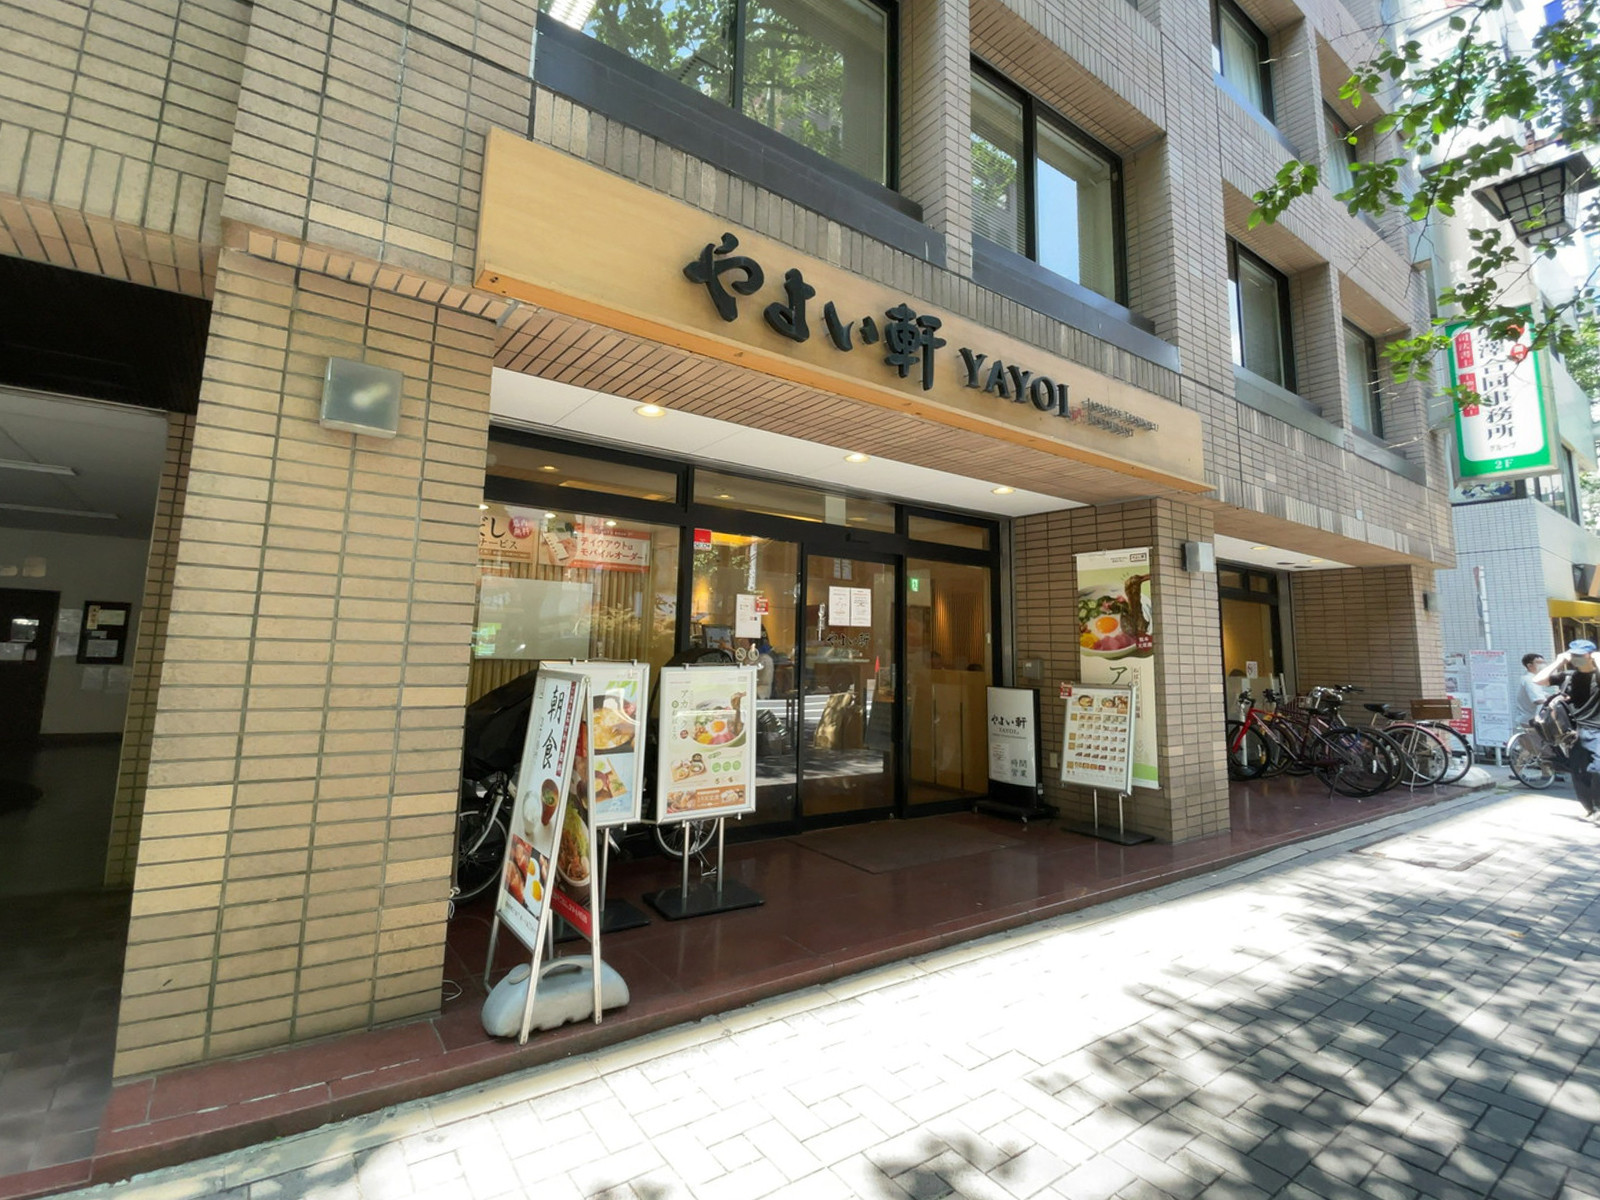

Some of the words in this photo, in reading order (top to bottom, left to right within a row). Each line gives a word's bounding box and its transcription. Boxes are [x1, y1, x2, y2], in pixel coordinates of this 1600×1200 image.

[683, 232, 947, 390] やよい軒
[958, 347, 1070, 418] YAYOI
[1495, 459, 1514, 470] 2F
[580, 547, 645, 562] モバイルオーダー
[542, 685, 565, 769] 朝食
[991, 715, 1027, 729] やよい軒
